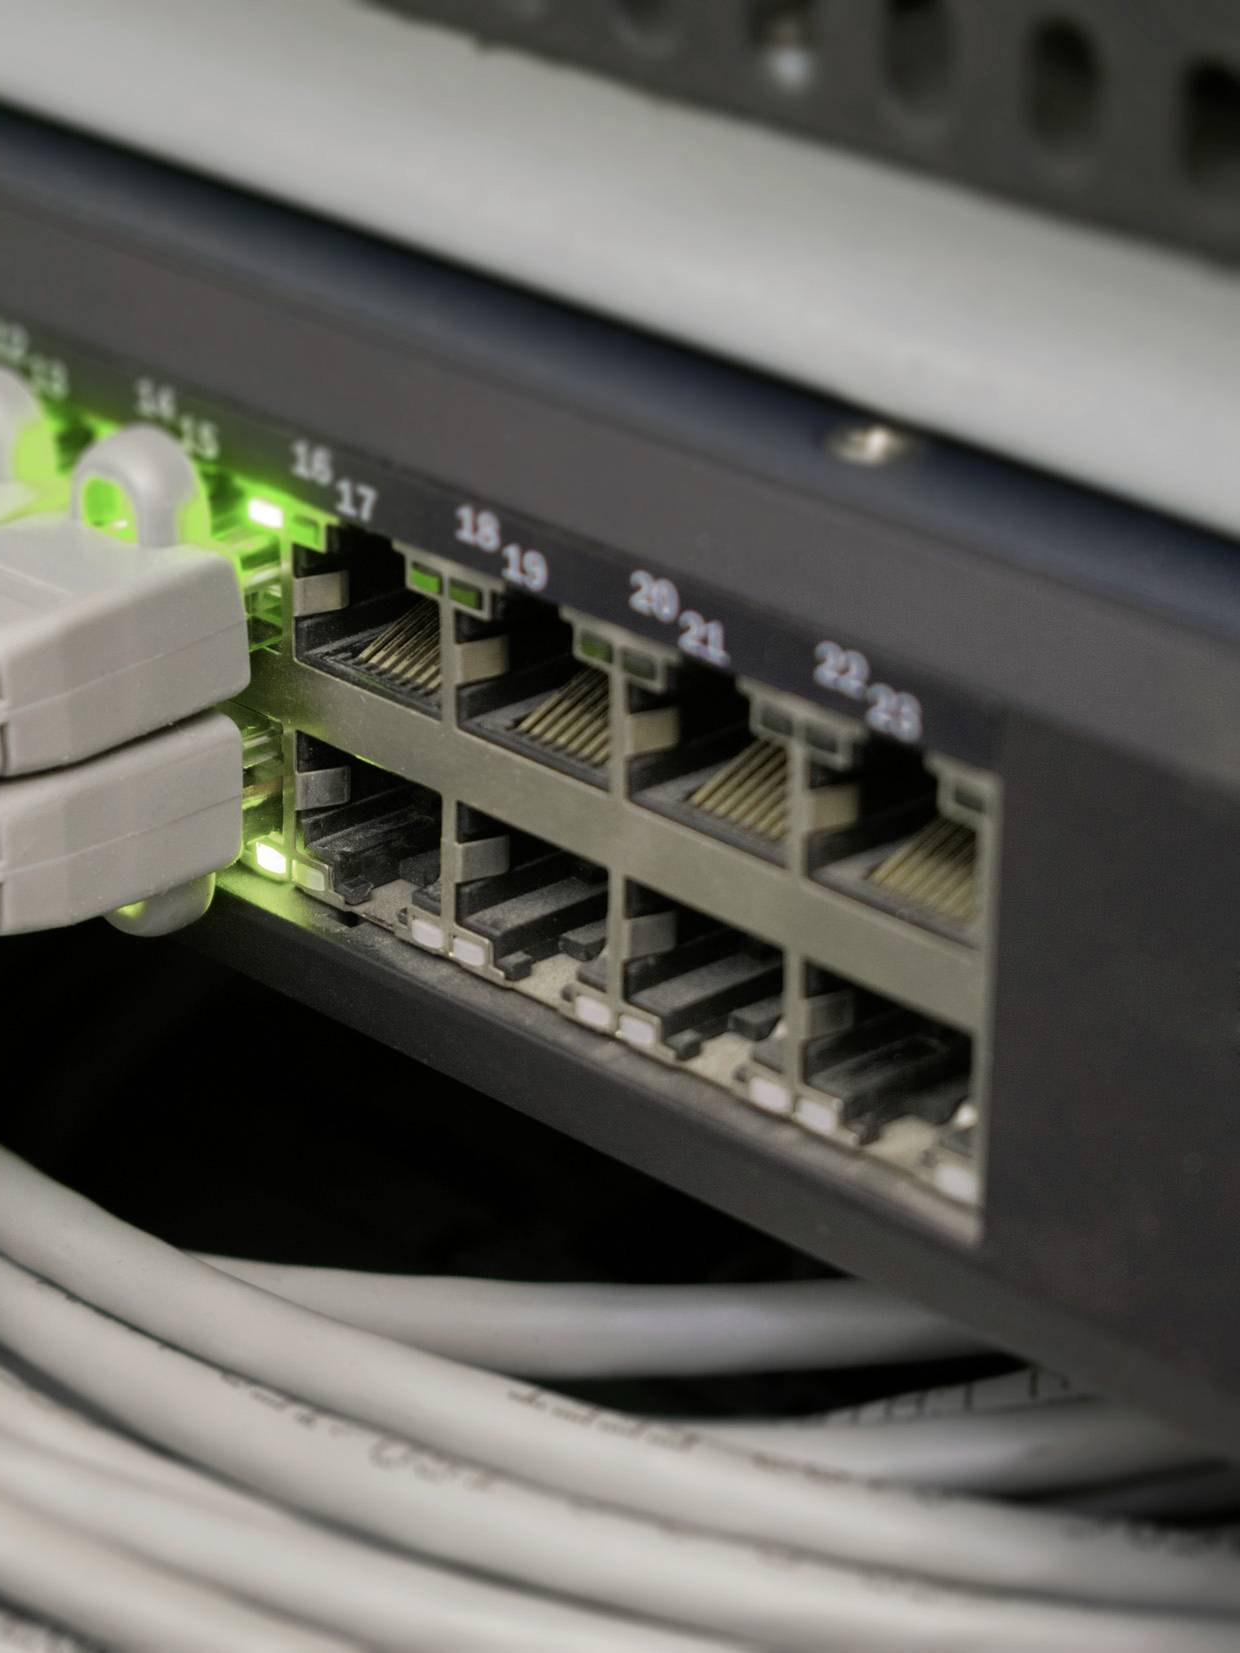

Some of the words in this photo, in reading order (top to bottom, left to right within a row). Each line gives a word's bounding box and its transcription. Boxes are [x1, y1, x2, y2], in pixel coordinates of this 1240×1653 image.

[181, 415, 220, 459] 15
[291, 440, 334, 485] 16
[335, 478, 378, 521] 17
[455, 504, 501, 551] 18
[502, 543, 548, 591] 19
[629, 570, 680, 623] 20
[678, 610, 730, 666] 21
[814, 641, 869, 699] 22
[866, 683, 921, 742] 23
